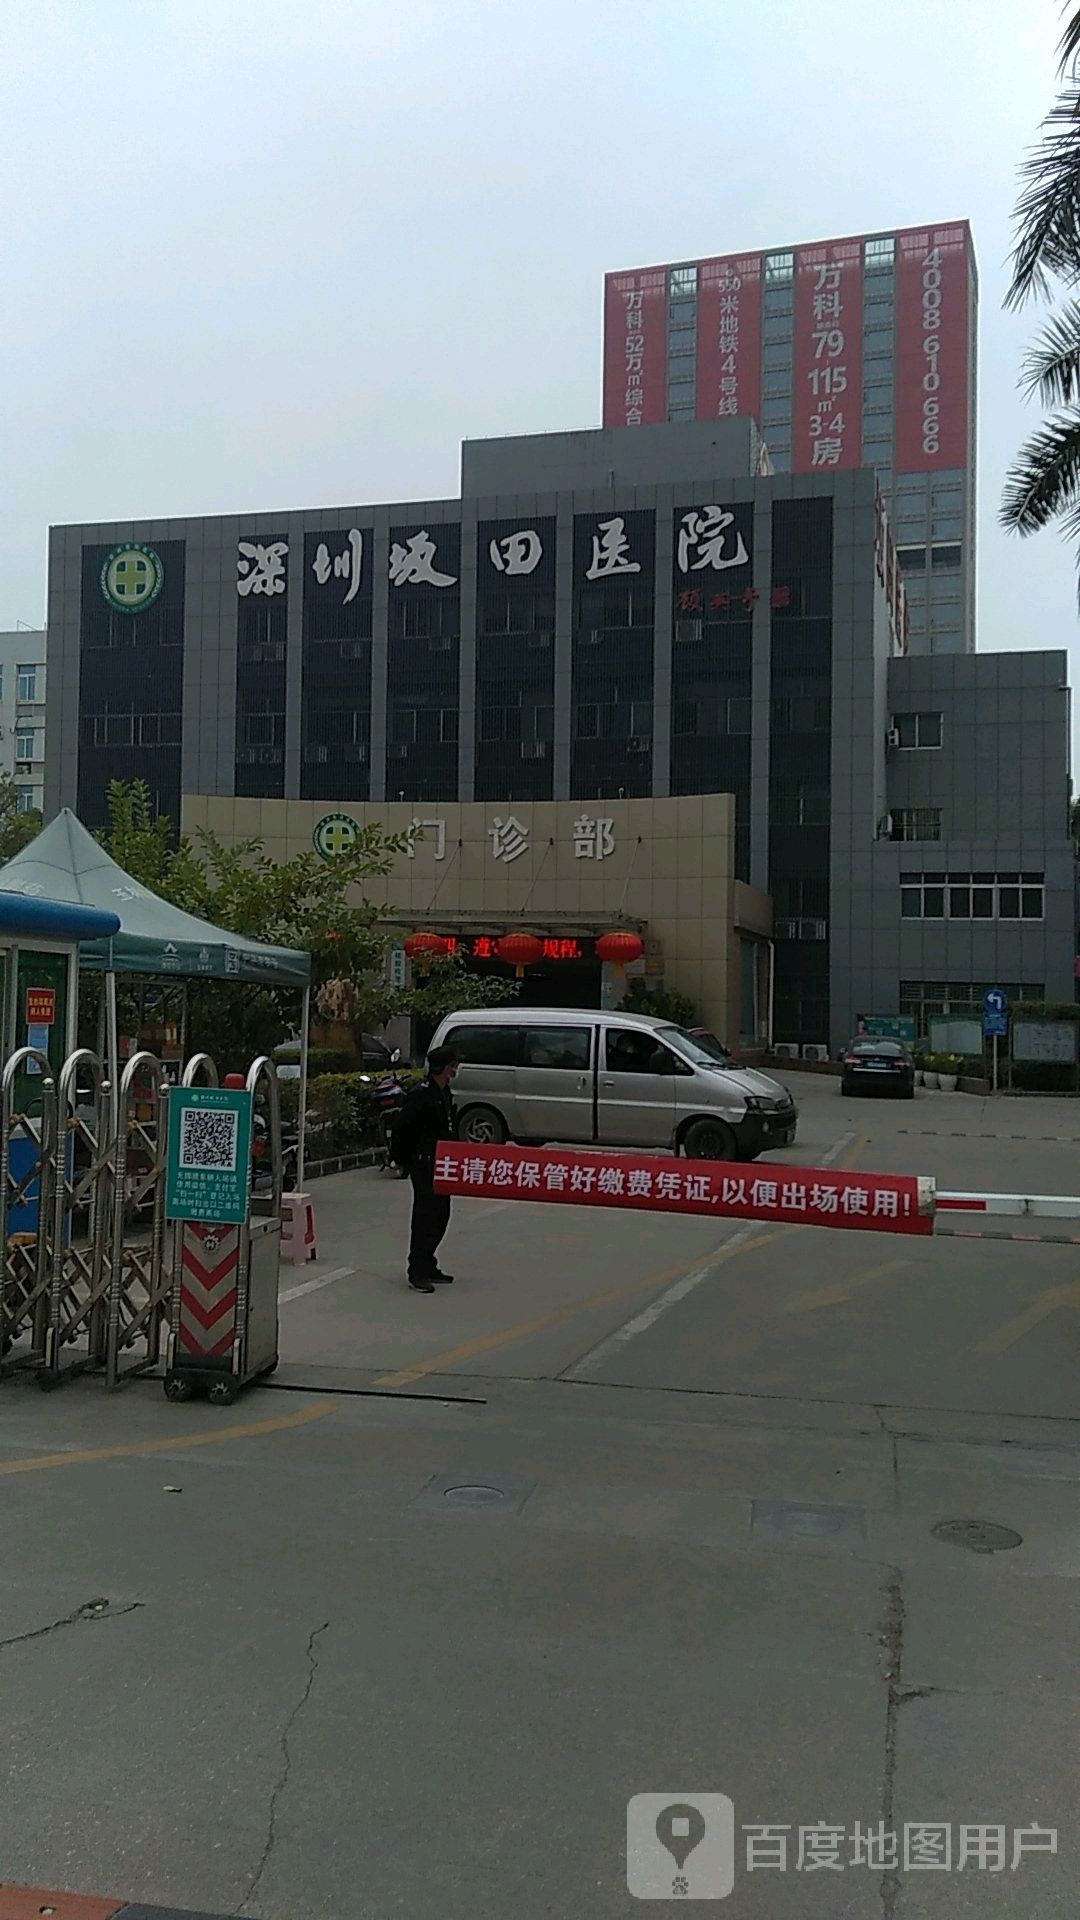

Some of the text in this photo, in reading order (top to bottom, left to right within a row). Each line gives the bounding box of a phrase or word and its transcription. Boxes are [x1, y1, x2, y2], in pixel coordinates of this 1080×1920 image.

[237, 505, 749, 604] 深圳坂田医院
[407, 814, 615, 863] 门诊部
